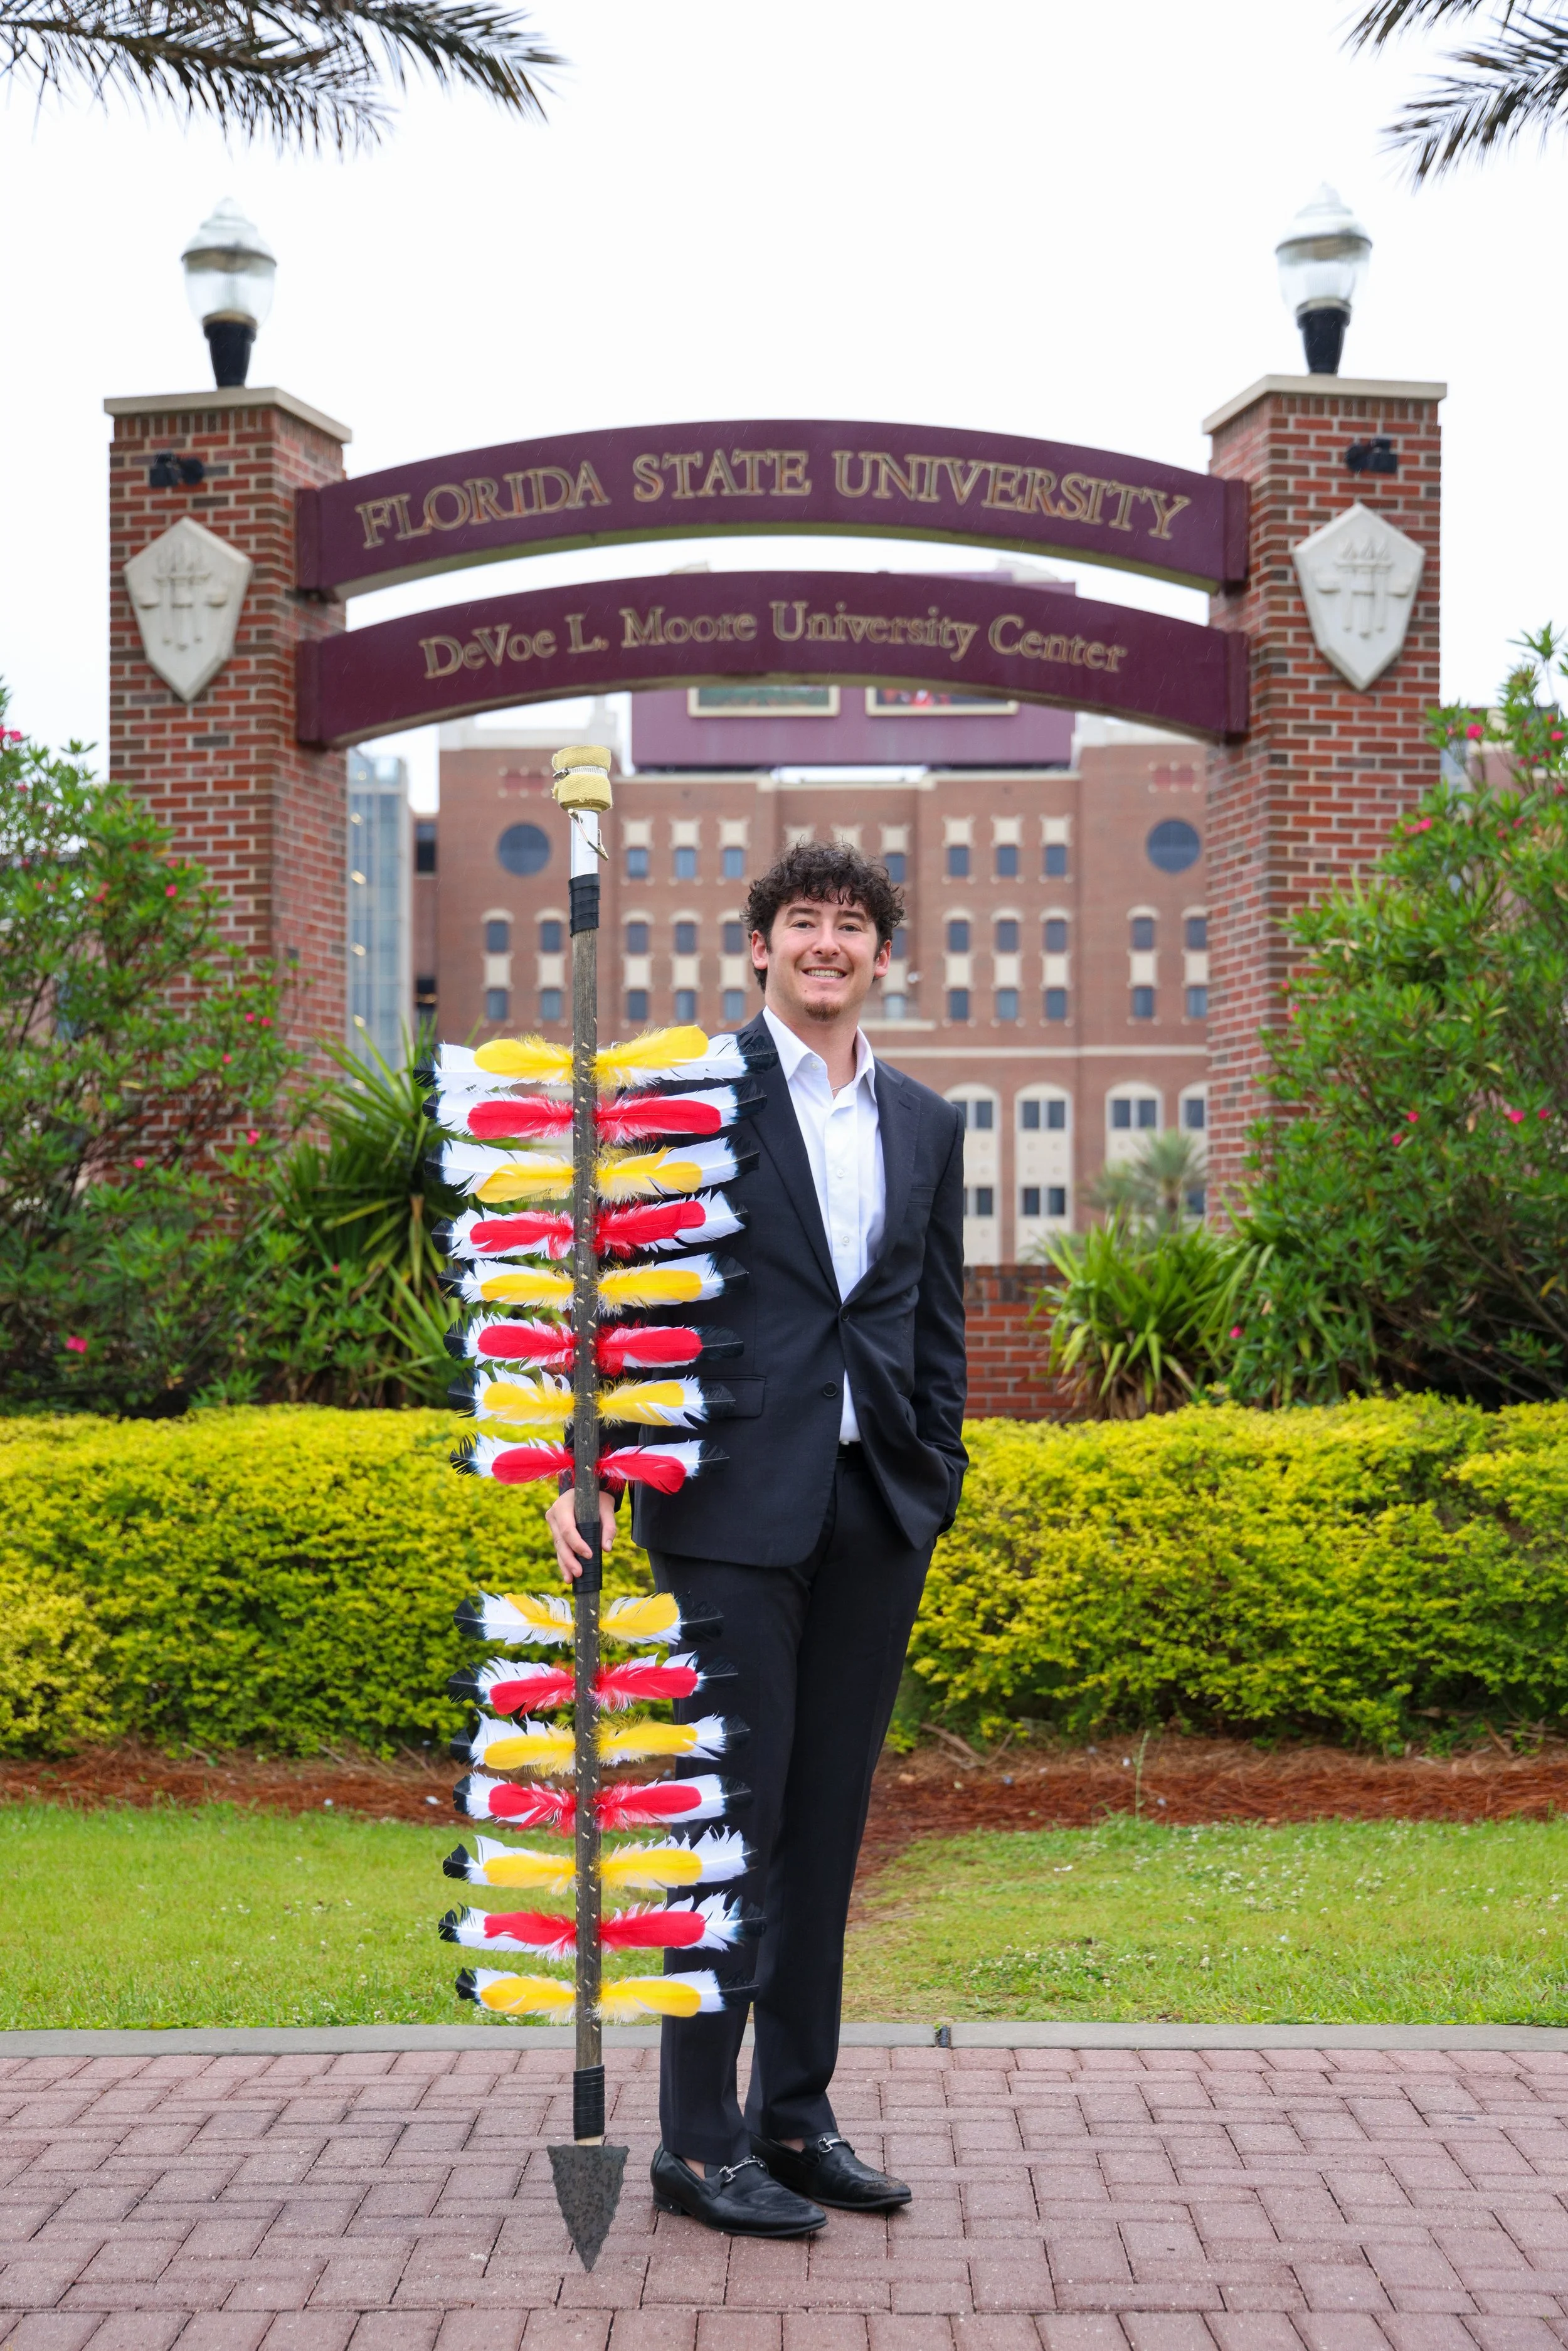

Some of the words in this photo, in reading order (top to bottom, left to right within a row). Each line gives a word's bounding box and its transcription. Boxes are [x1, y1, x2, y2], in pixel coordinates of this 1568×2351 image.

[356, 461, 612, 549] FLORIDA
[632, 449, 812, 502] STATE
[832, 450, 1190, 540] UNIVERSITY
[418, 624, 556, 679] DeVoe
[619, 606, 758, 649] Moore
[770, 601, 979, 662] University
[988, 614, 1128, 673] Center
